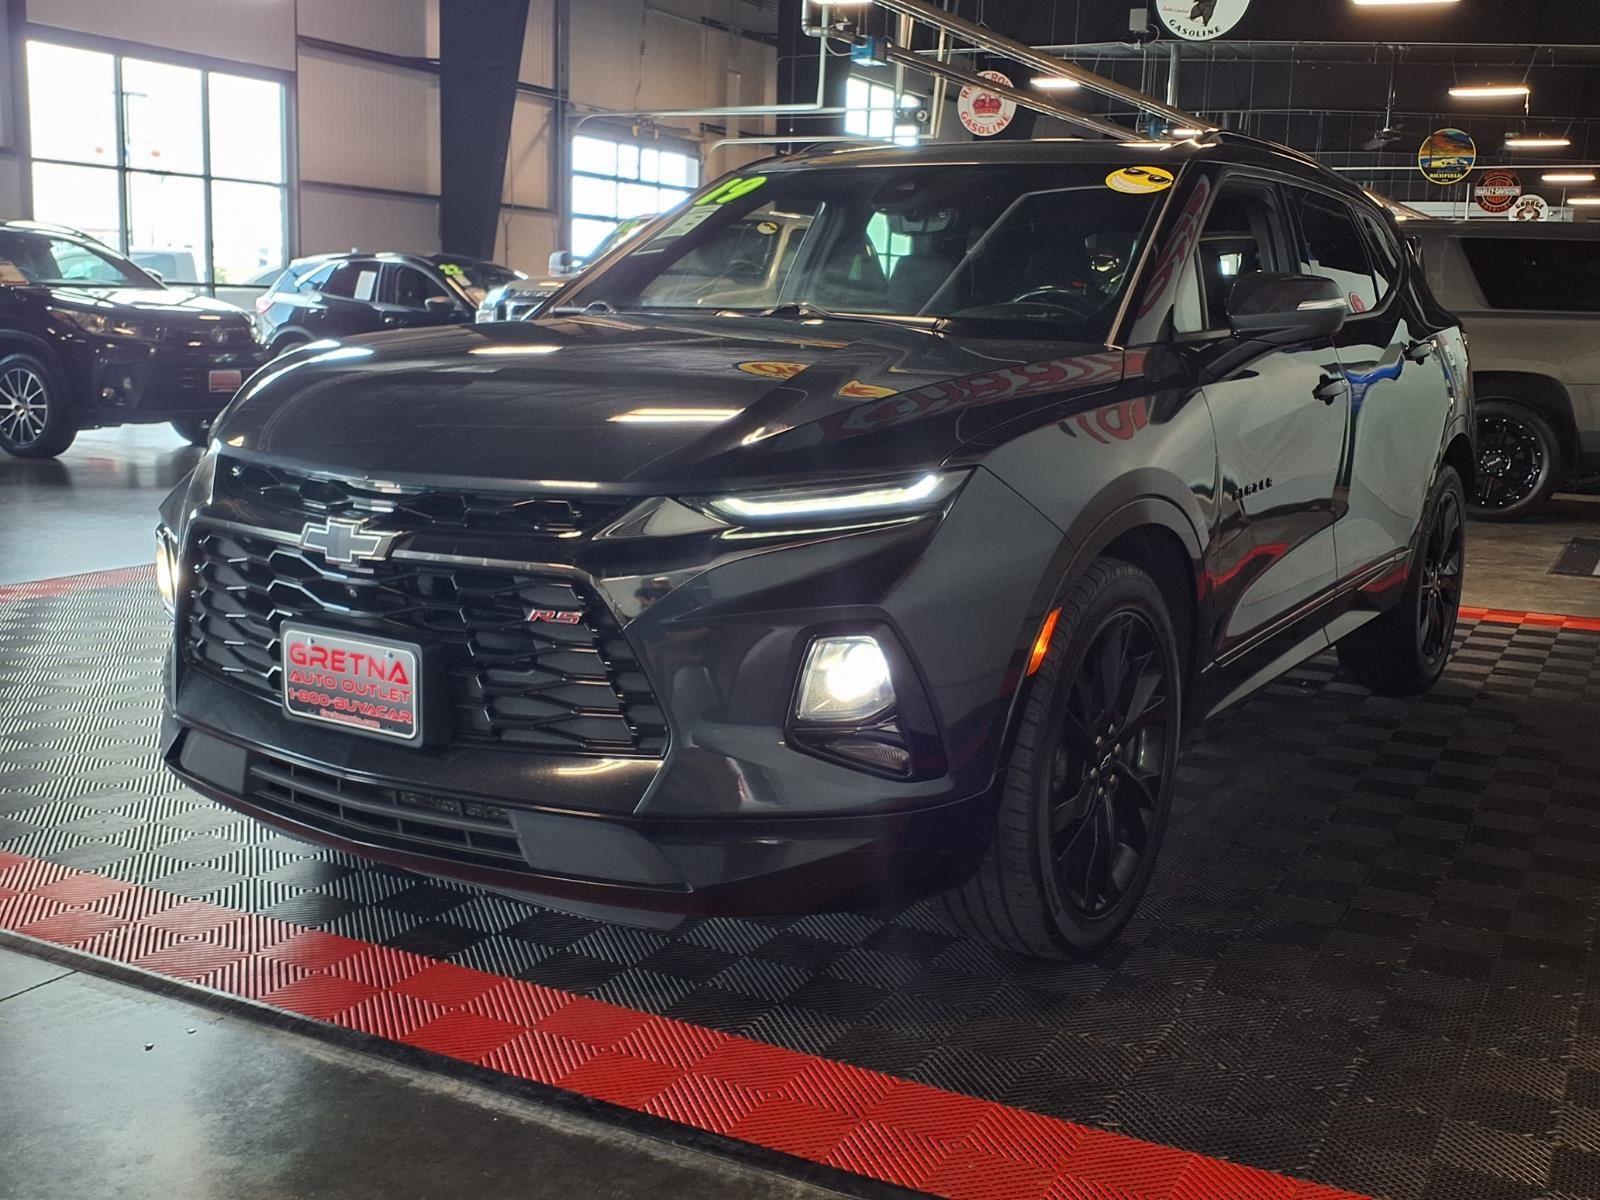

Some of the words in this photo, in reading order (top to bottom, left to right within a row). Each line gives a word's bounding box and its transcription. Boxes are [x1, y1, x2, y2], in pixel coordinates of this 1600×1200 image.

[1169, 19, 1221, 37] GASOLINE
[961, 111, 1011, 134] GASOLINE
[694, 175, 768, 206] 19
[525, 609, 583, 625] RS
[289, 643, 409, 686] GRETNA
[288, 669, 338, 690] AUTO
[341, 678, 412, 704] OUTLET
